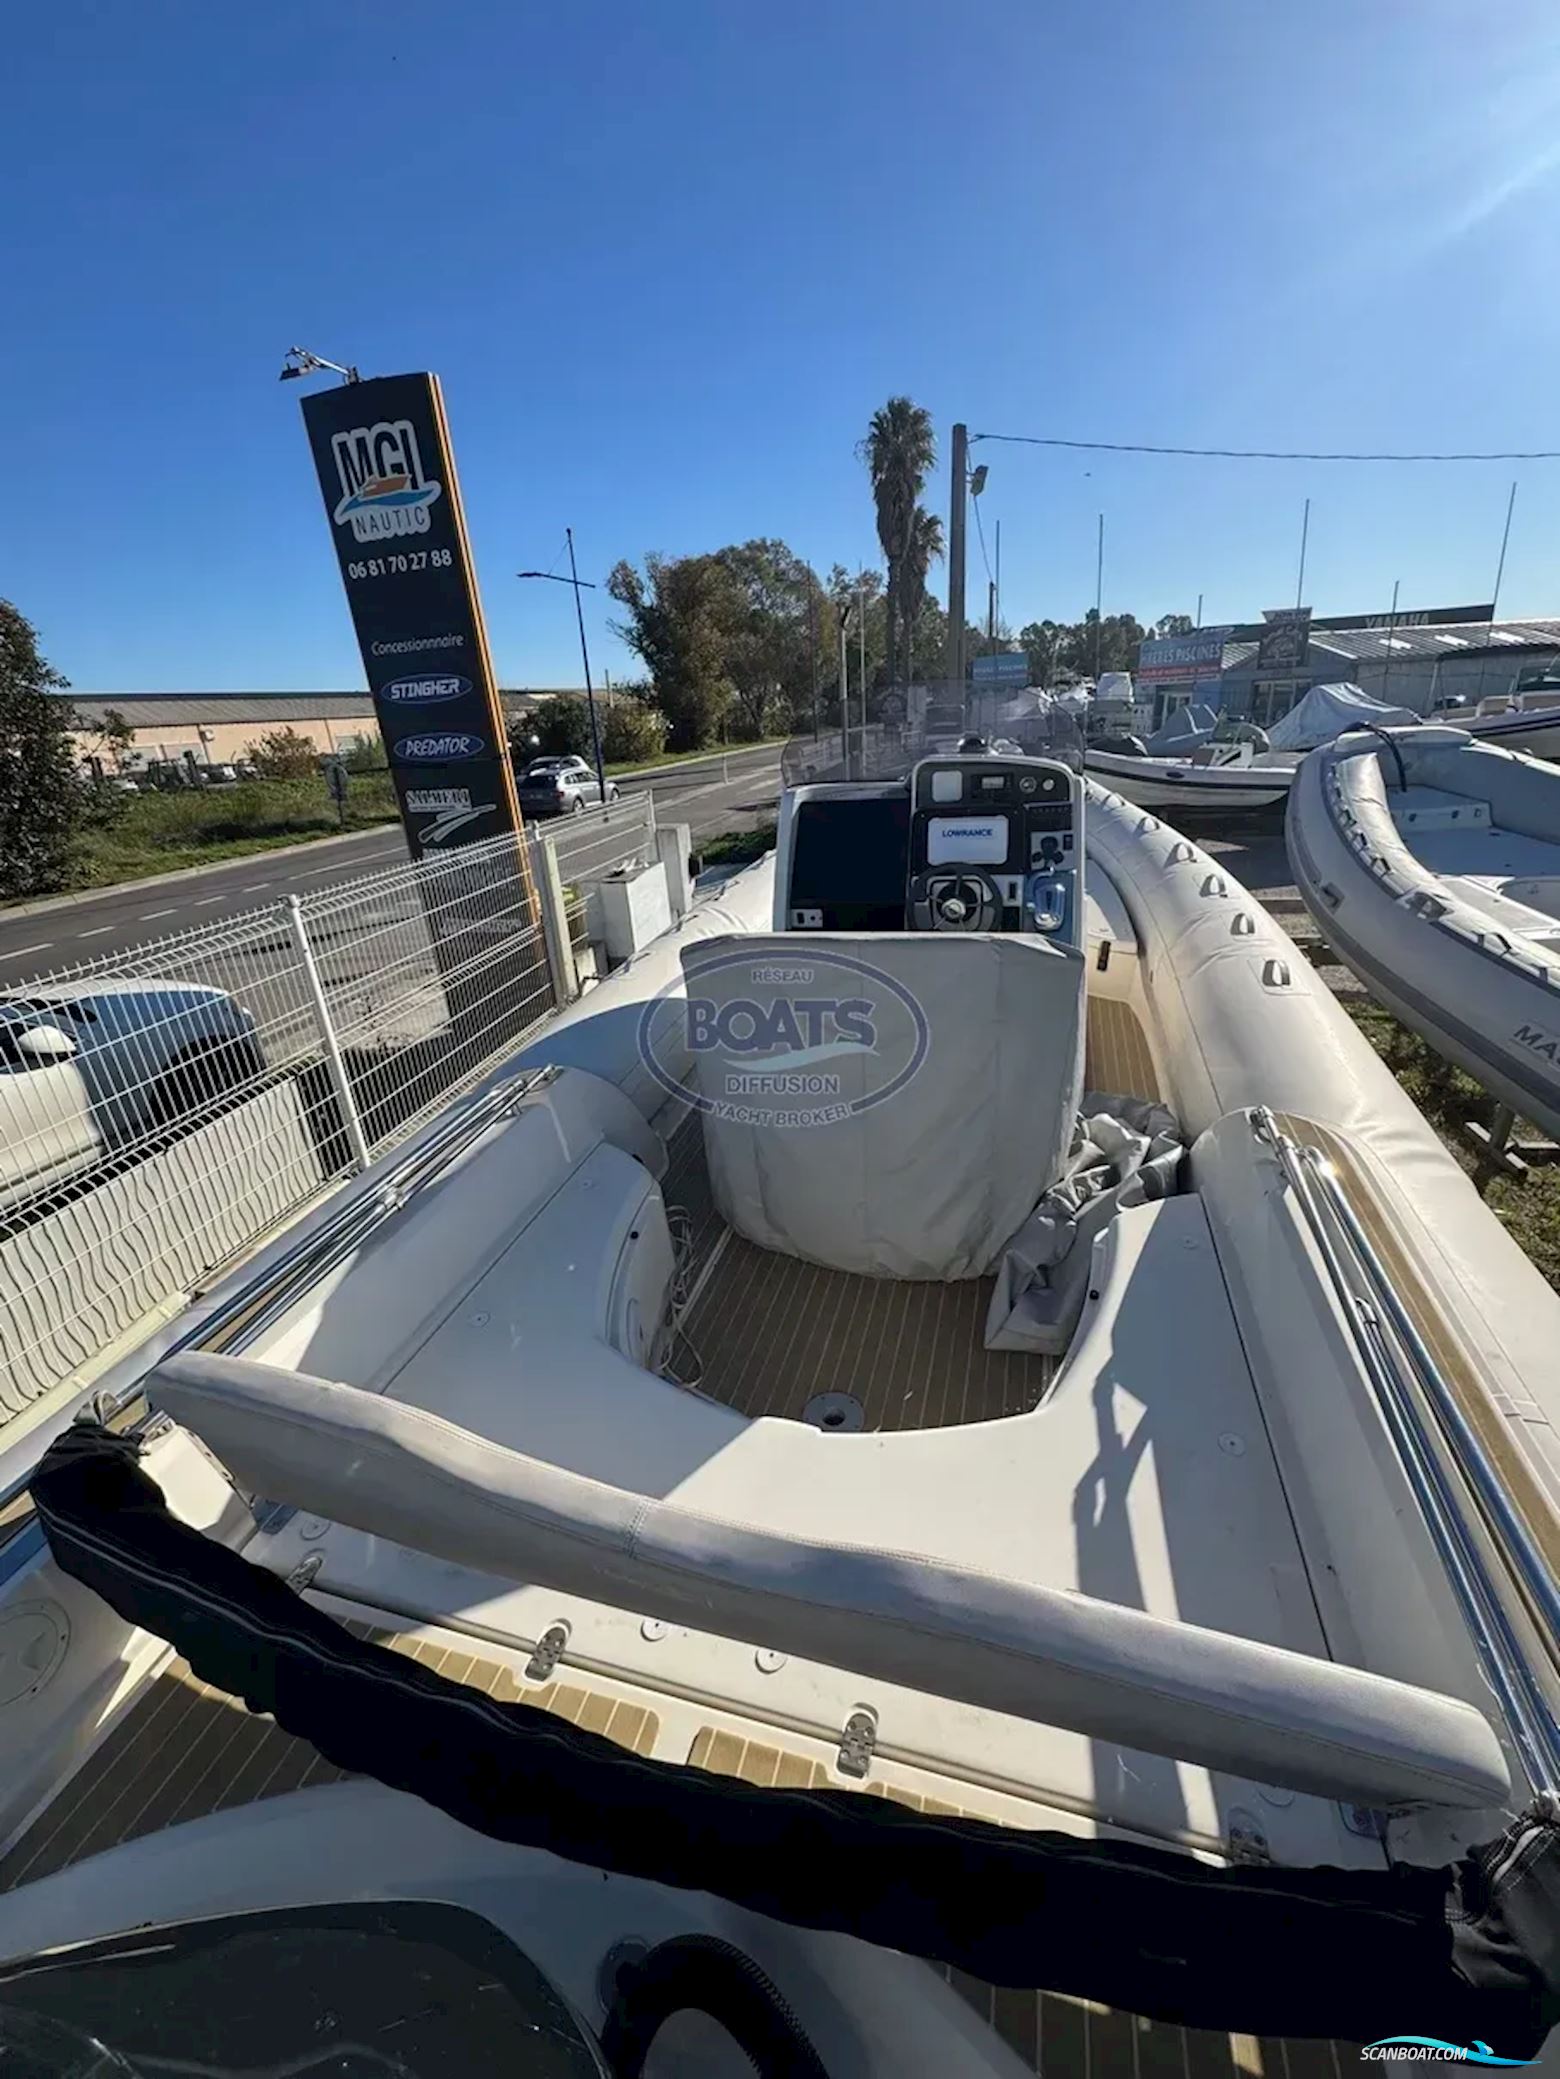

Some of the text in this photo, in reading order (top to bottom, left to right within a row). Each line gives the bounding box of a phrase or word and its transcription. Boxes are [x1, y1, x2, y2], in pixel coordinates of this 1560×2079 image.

[335, 426, 420, 498] MGI
[355, 505, 426, 536] NAUTIC
[349, 549, 452, 580] 06 81 70 27 88
[390, 678, 461, 700] STINGHER
[405, 736, 471, 757] PREDATOR
[942, 828, 993, 838] LOWRANCE
[1513, 1025, 1560, 1065] MA
